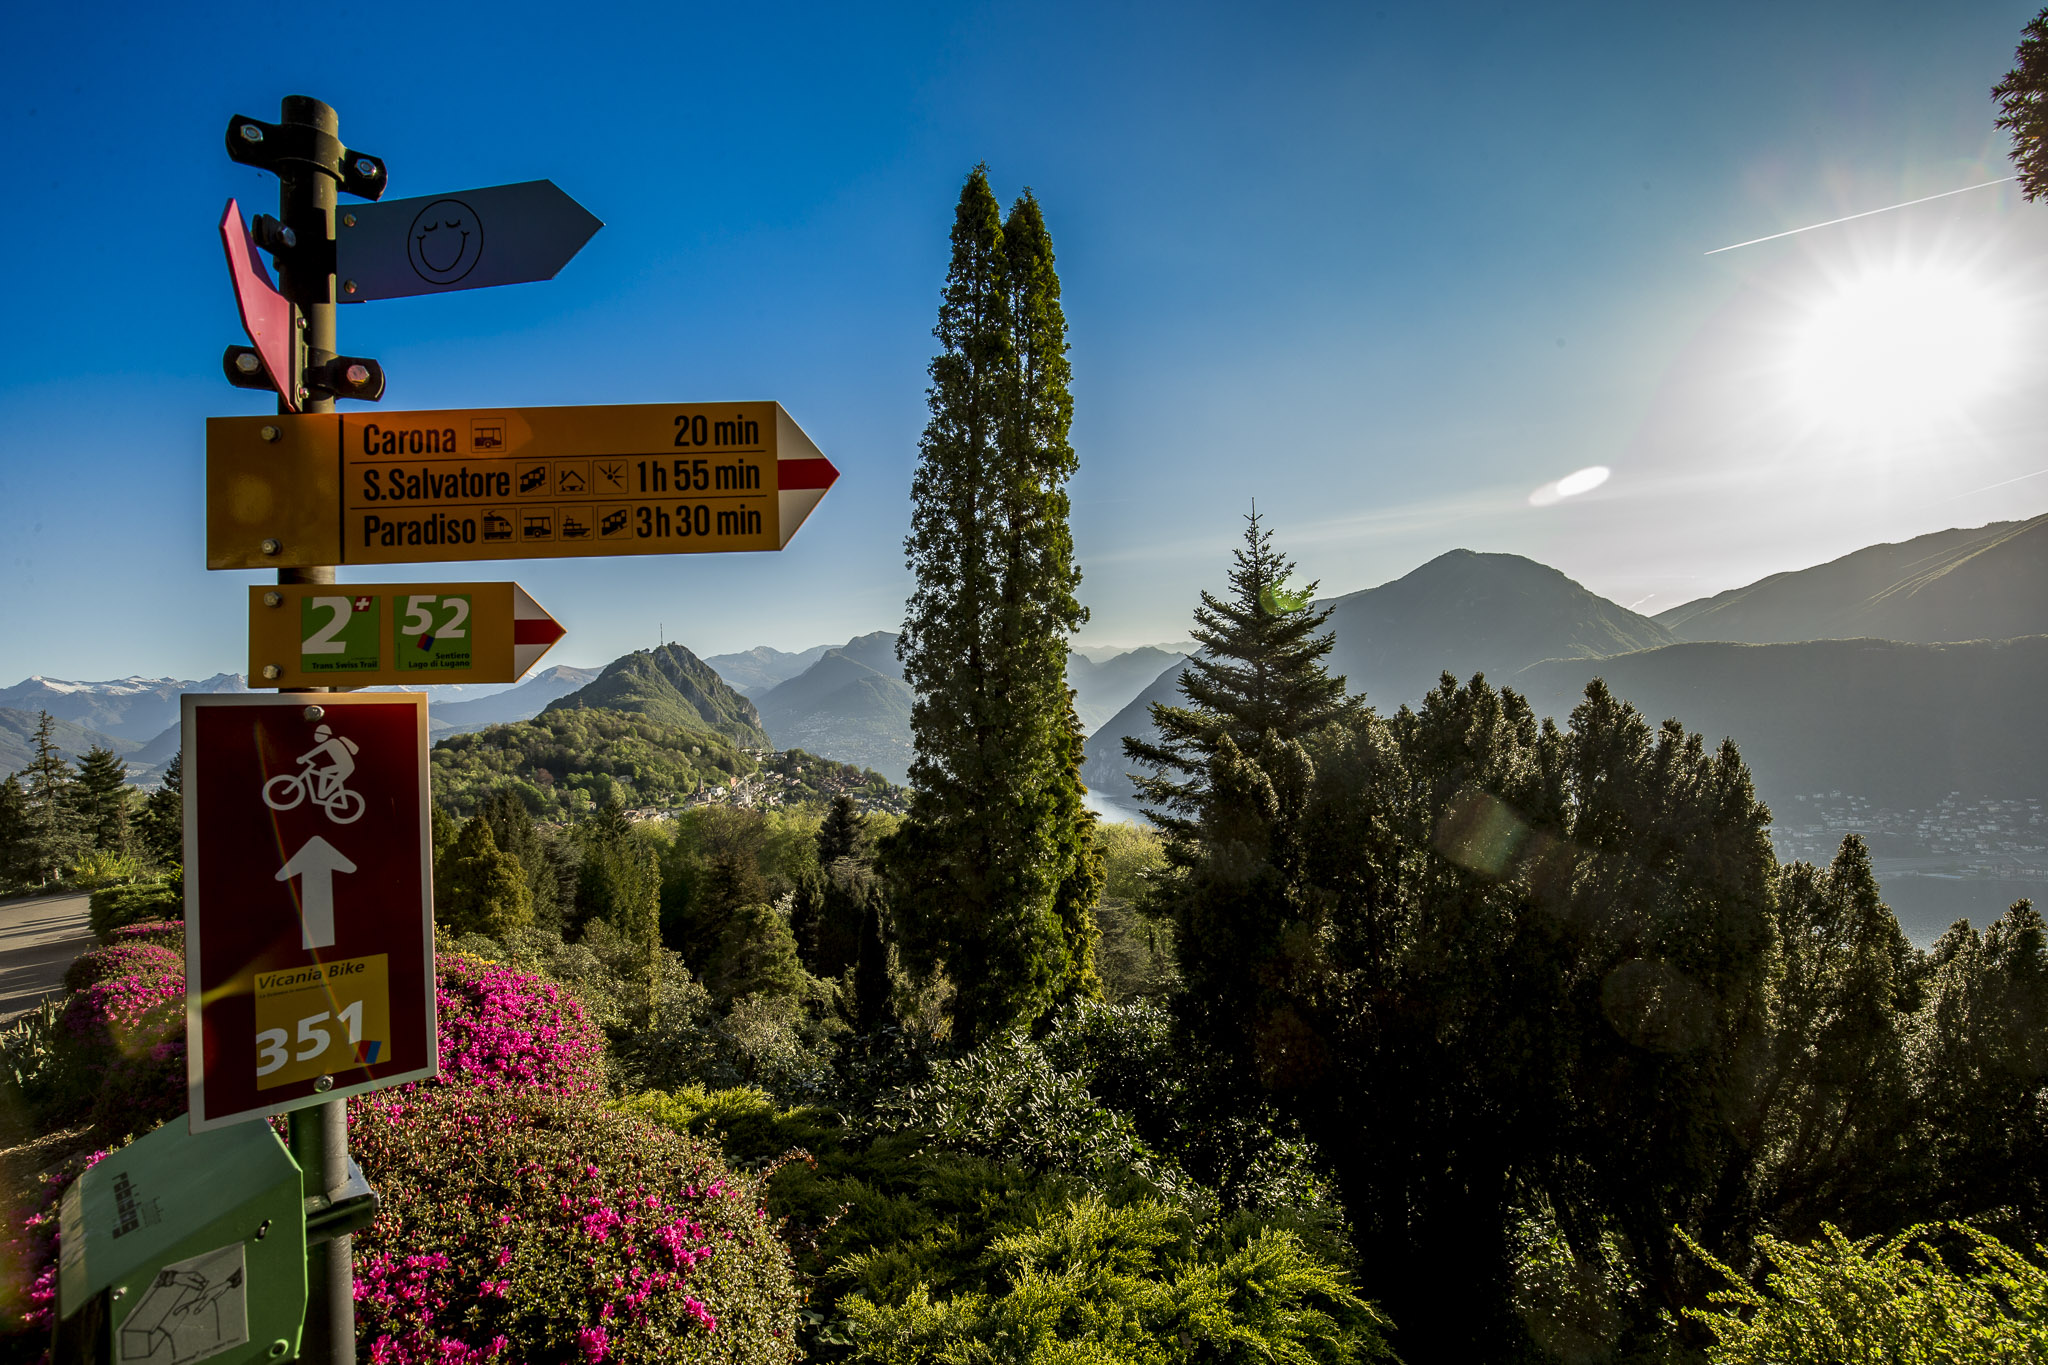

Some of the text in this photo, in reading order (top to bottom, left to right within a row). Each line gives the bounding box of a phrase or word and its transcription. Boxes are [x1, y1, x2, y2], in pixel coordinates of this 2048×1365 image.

[363, 414, 759, 456] Carona 20 min
[363, 466, 511, 501] S.Salvatore
[674, 459, 709, 491] 55
[715, 458, 760, 490] min
[363, 512, 477, 547] Paradiso
[676, 504, 710, 537] 30
[716, 504, 762, 536] min
[301, 596, 353, 655] 2
[401, 594, 470, 639] 52
[335, 660, 358, 669] Swiss
[360, 660, 378, 669] Trail
[408, 659, 471, 670] Lago di Lugano
[435, 651, 471, 660] Sentiero
[258, 961, 366, 990] Vicania Bike
[256, 1000, 363, 1077] 351
